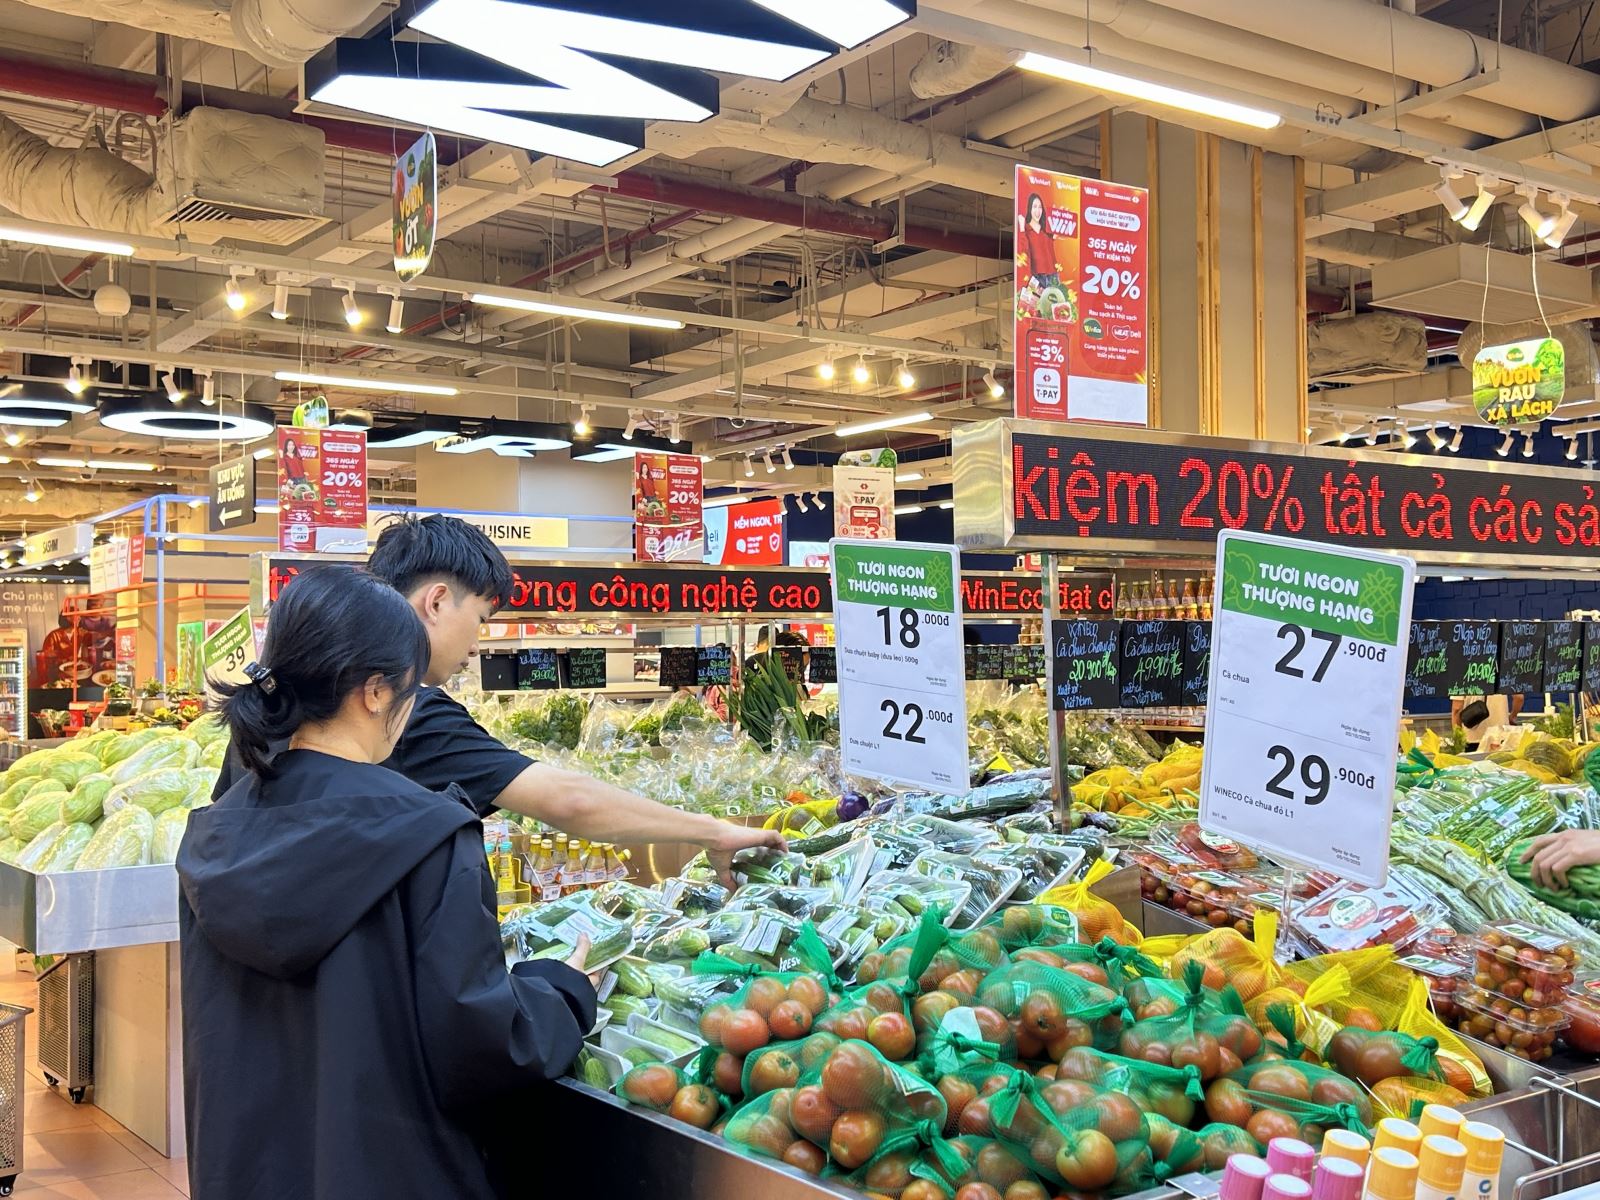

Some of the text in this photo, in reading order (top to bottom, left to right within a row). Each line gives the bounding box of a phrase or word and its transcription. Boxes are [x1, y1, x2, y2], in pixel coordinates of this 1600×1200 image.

[1088, 237, 1137, 254] 365 NGÀY
[1082, 264, 1140, 300] 20%
[1041, 344, 1064, 363] 3%
[1036, 389, 1058, 399] T-PAY
[1500, 384, 1535, 403] RAU
[1487, 400, 1552, 421] XÀ LÁCH
[322, 471, 362, 488] 20%
[669, 491, 700, 504] 20%
[854, 496, 875, 504] T-PAY
[1014, 445, 1158, 537] kiệm
[1179, 458, 1305, 532] 20%
[1321, 460, 1386, 536] tất
[1400, 474, 1454, 540] cả
[1468, 484, 1543, 545] các
[296, 513, 311, 521] 3%
[476, 525, 531, 539] UISINE
[857, 561, 924, 579] TƯƠI NGON
[1259, 563, 1360, 597] TƯƠI NGON
[2, 591, 25, 600] Chủ
[590, 575, 670, 614] công
[682, 576, 758, 614] nghệ
[769, 585, 821, 608] cao
[1058, 583, 1091, 614] đạt
[1098, 583, 1114, 609] c
[848, 578, 938, 600] THƯỢNG HẠNG
[1242, 584, 1374, 624] THƯỢNG HẠNG
[876, 606, 920, 648] 18
[226, 646, 246, 672] 39
[1274, 623, 1342, 683] 27
[1222, 669, 1250, 684] Cà chua
[880, 700, 926, 744] 22
[1266, 745, 1330, 805] 29
[1214, 785, 1294, 819] WINECO Cà chua đỏ L1
